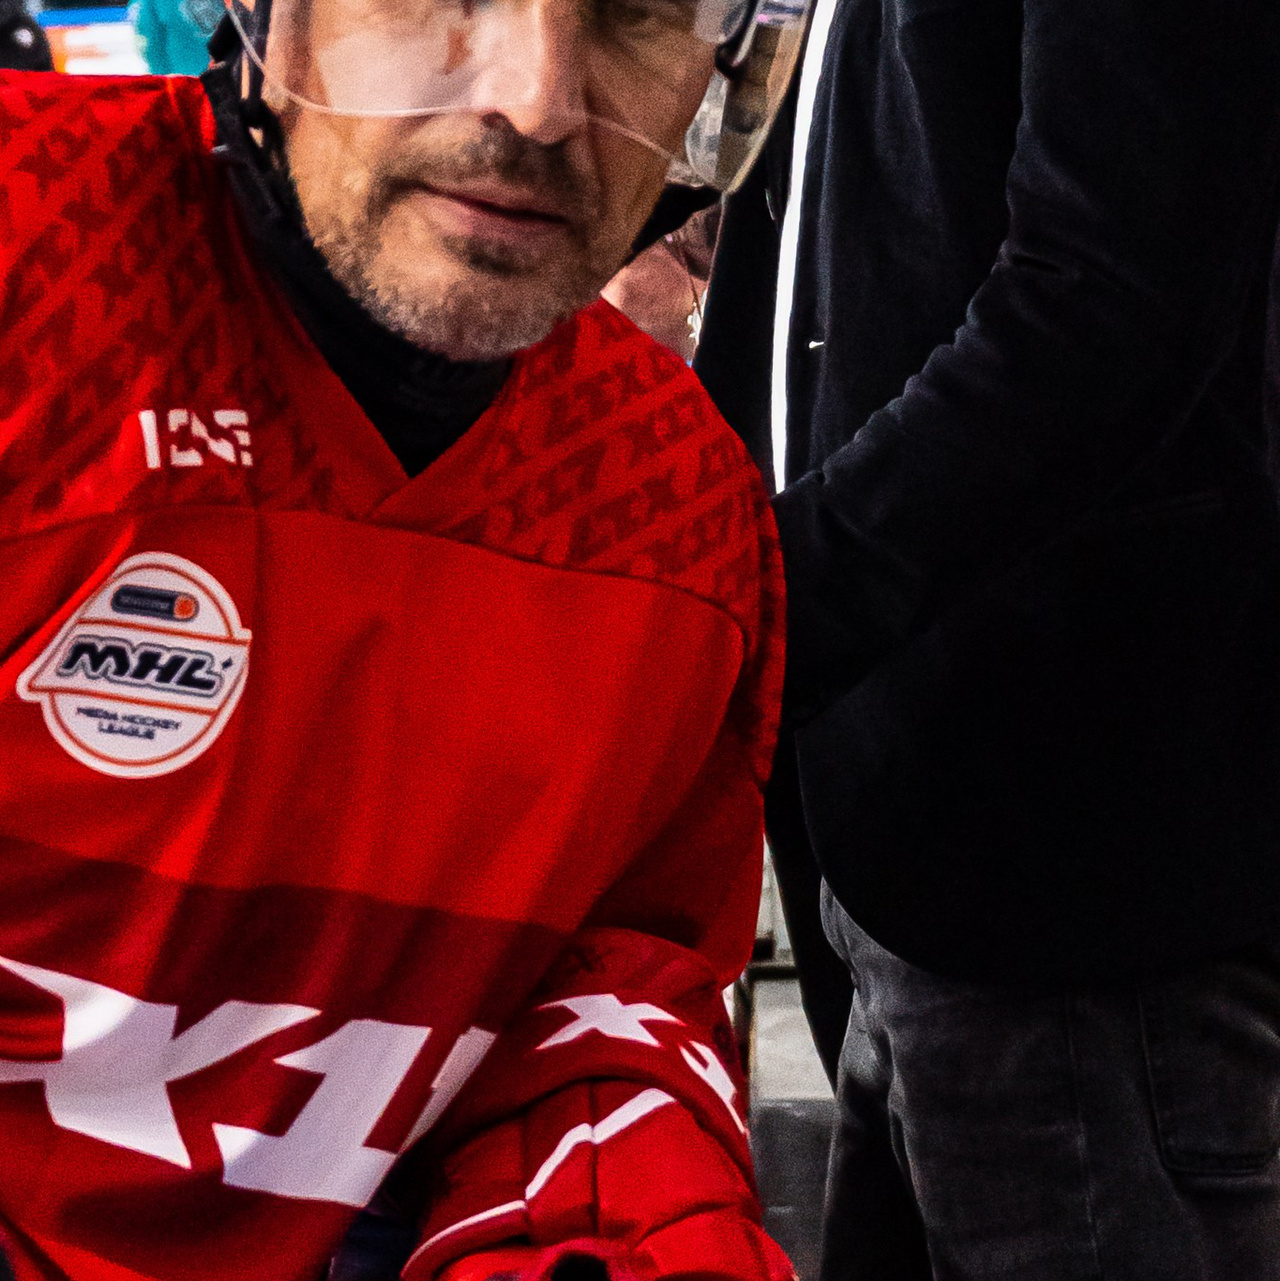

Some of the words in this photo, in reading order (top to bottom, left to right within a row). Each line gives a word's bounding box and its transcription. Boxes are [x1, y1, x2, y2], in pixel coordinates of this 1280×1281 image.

[61, 641, 217, 691] MHL
[97, 720, 155, 740] LEAGUE
[121, 714, 182, 730] HOCKEY
